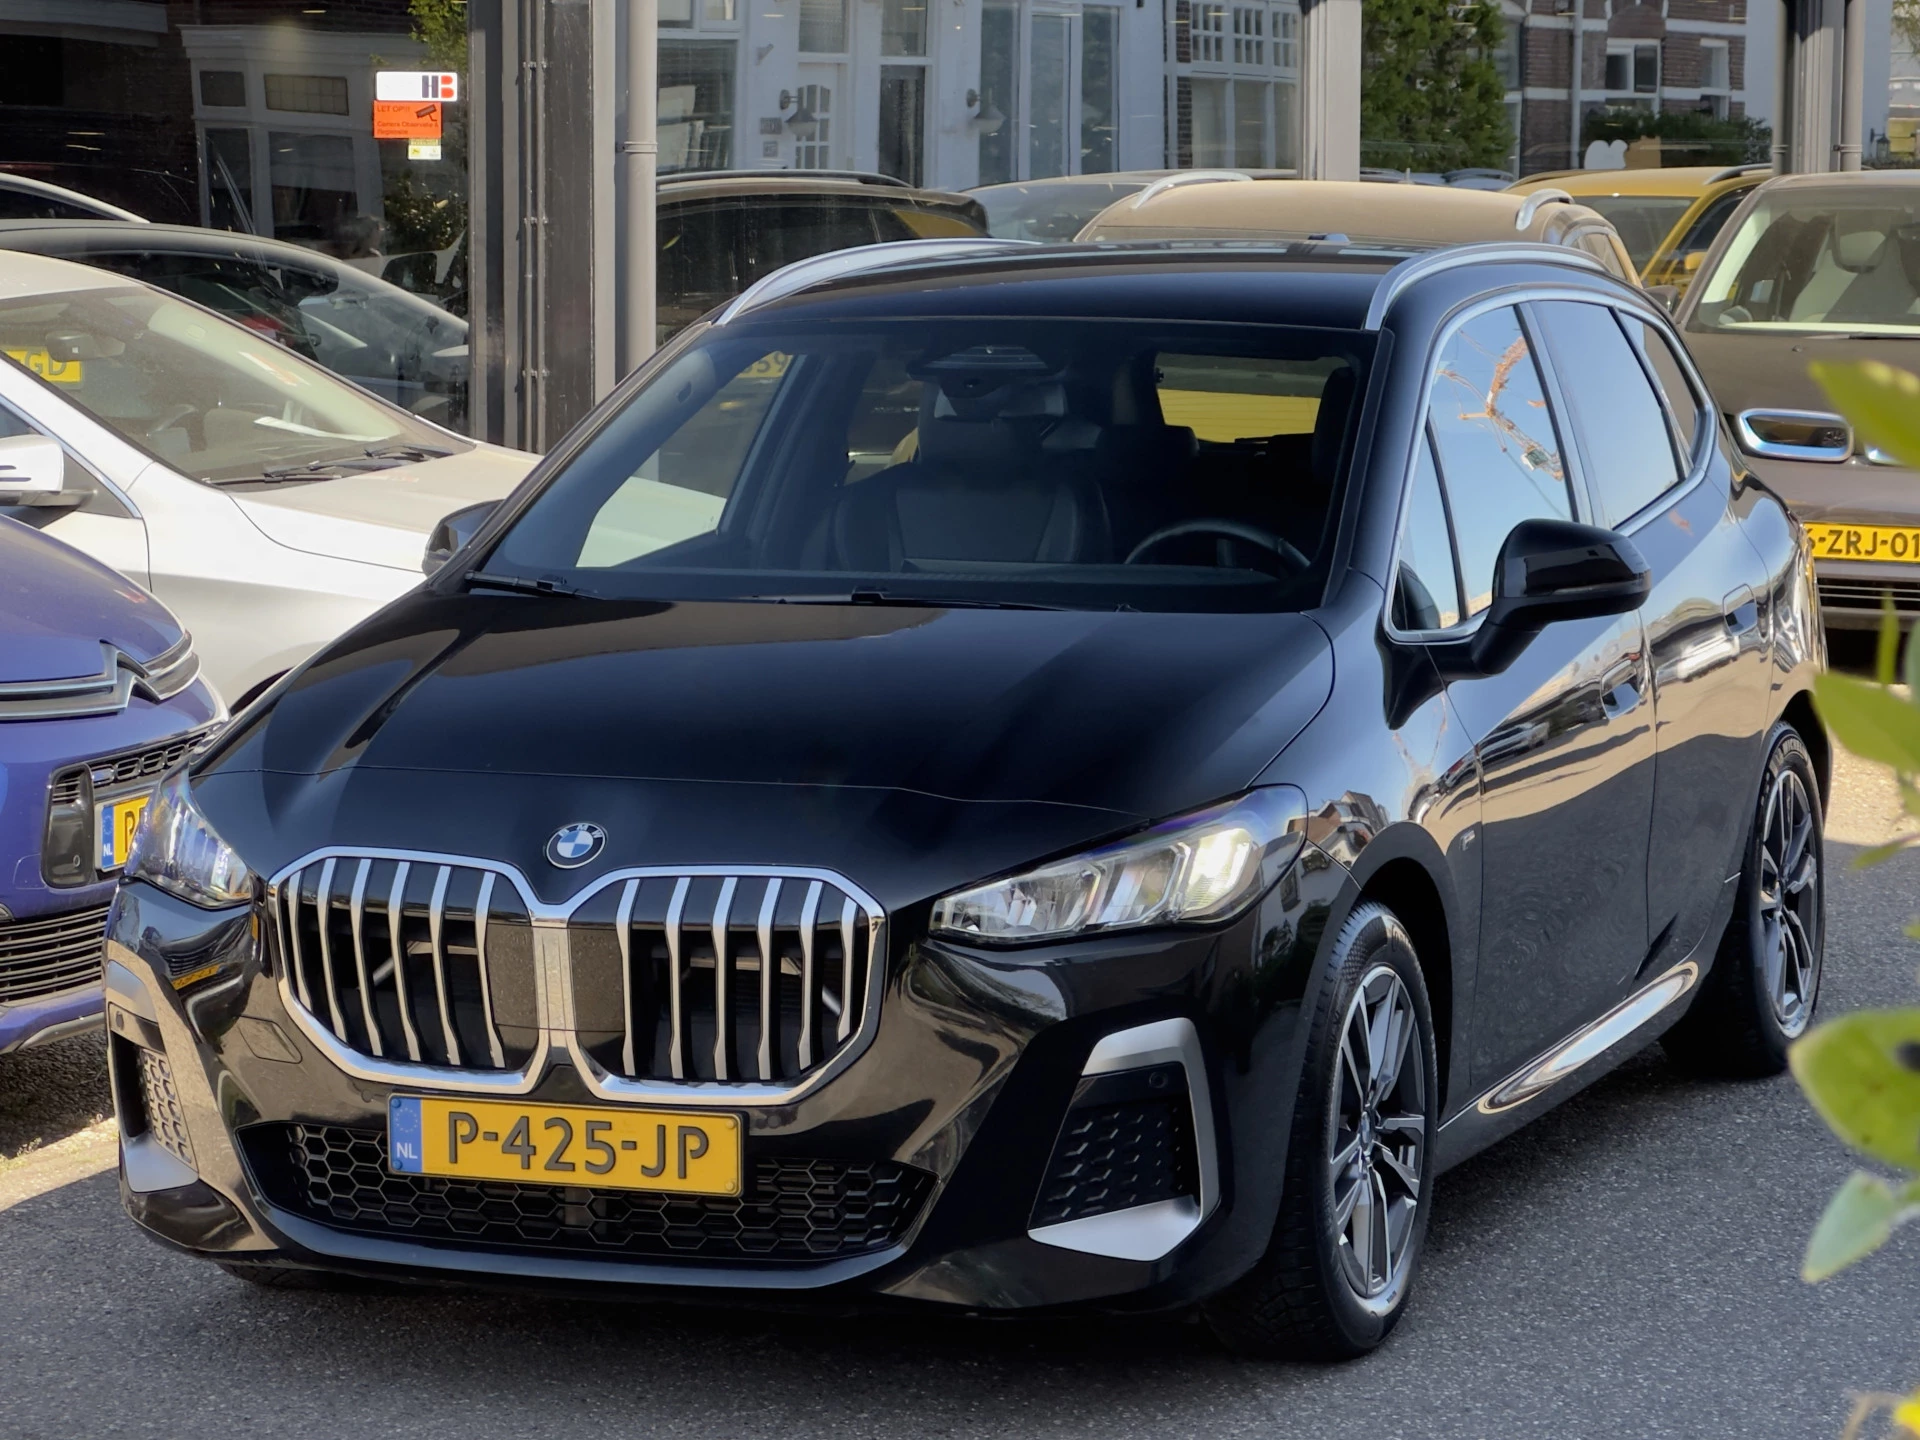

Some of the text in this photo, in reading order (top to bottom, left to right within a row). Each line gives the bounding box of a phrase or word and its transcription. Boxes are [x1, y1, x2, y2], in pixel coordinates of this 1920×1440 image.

[422, 75, 454, 98] HB
[558, 823, 603, 838] BMW
[103, 843, 113, 857] NL
[396, 1142, 418, 1160] NL
[448, 1111, 710, 1179] P-425-JP
